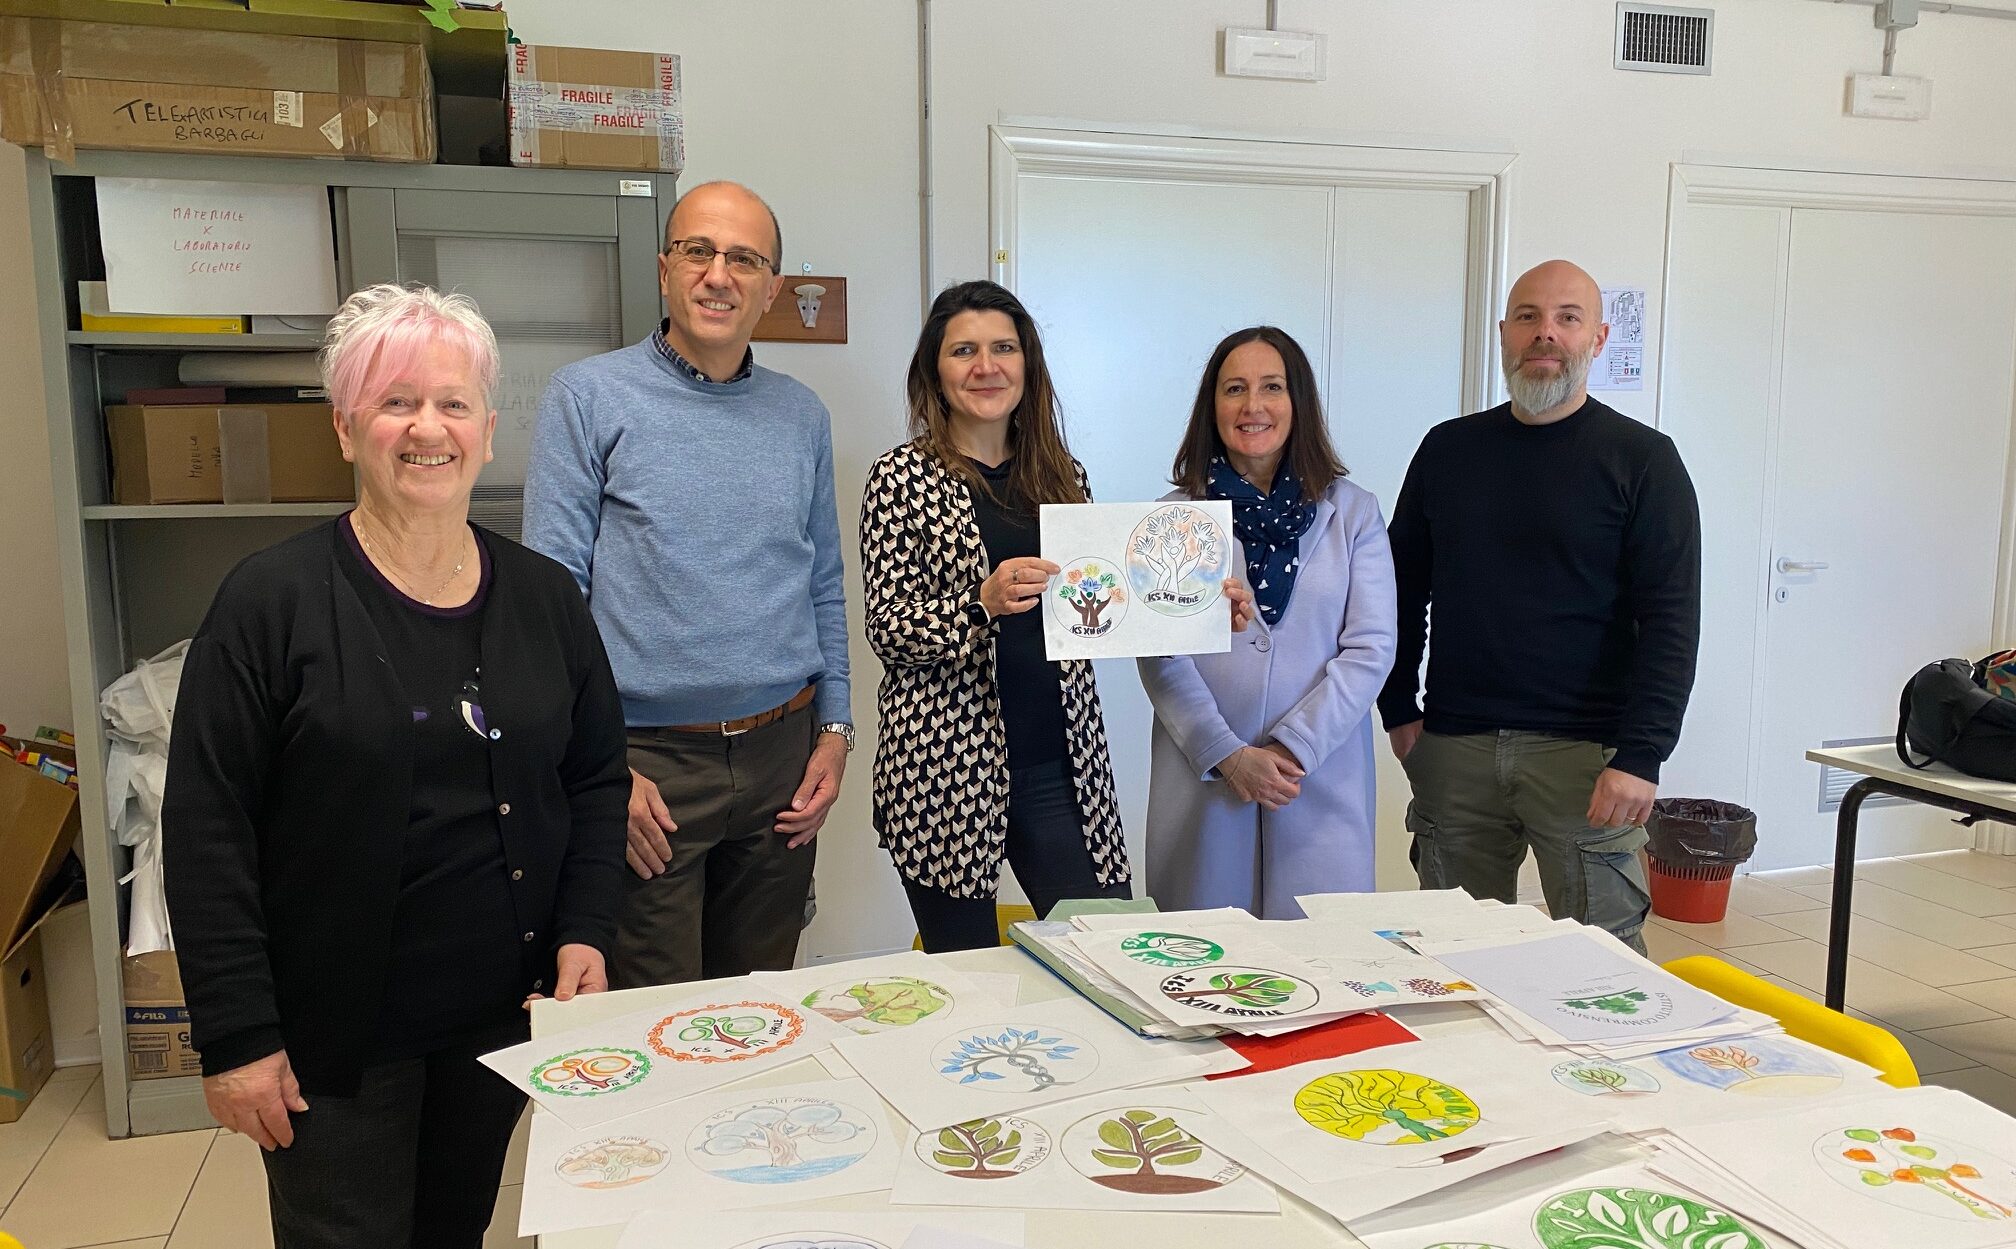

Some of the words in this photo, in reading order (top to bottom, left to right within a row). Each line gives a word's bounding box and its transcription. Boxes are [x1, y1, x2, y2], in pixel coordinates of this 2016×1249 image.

[661, 56, 673, 107] FRAGILE
[562, 89, 613, 105] FRAGILE
[278, 103, 290, 121] 103
[594, 114, 646, 129] FRAGILE
[173, 207, 244, 222] MATERIALE
[188, 261, 242, 275] SCIENZE
[141, 1012, 167, 1020] FILA
[1555, 1007, 1658, 1026] COMPRENSIVO
[1005, 1117, 1029, 1130] ICS
